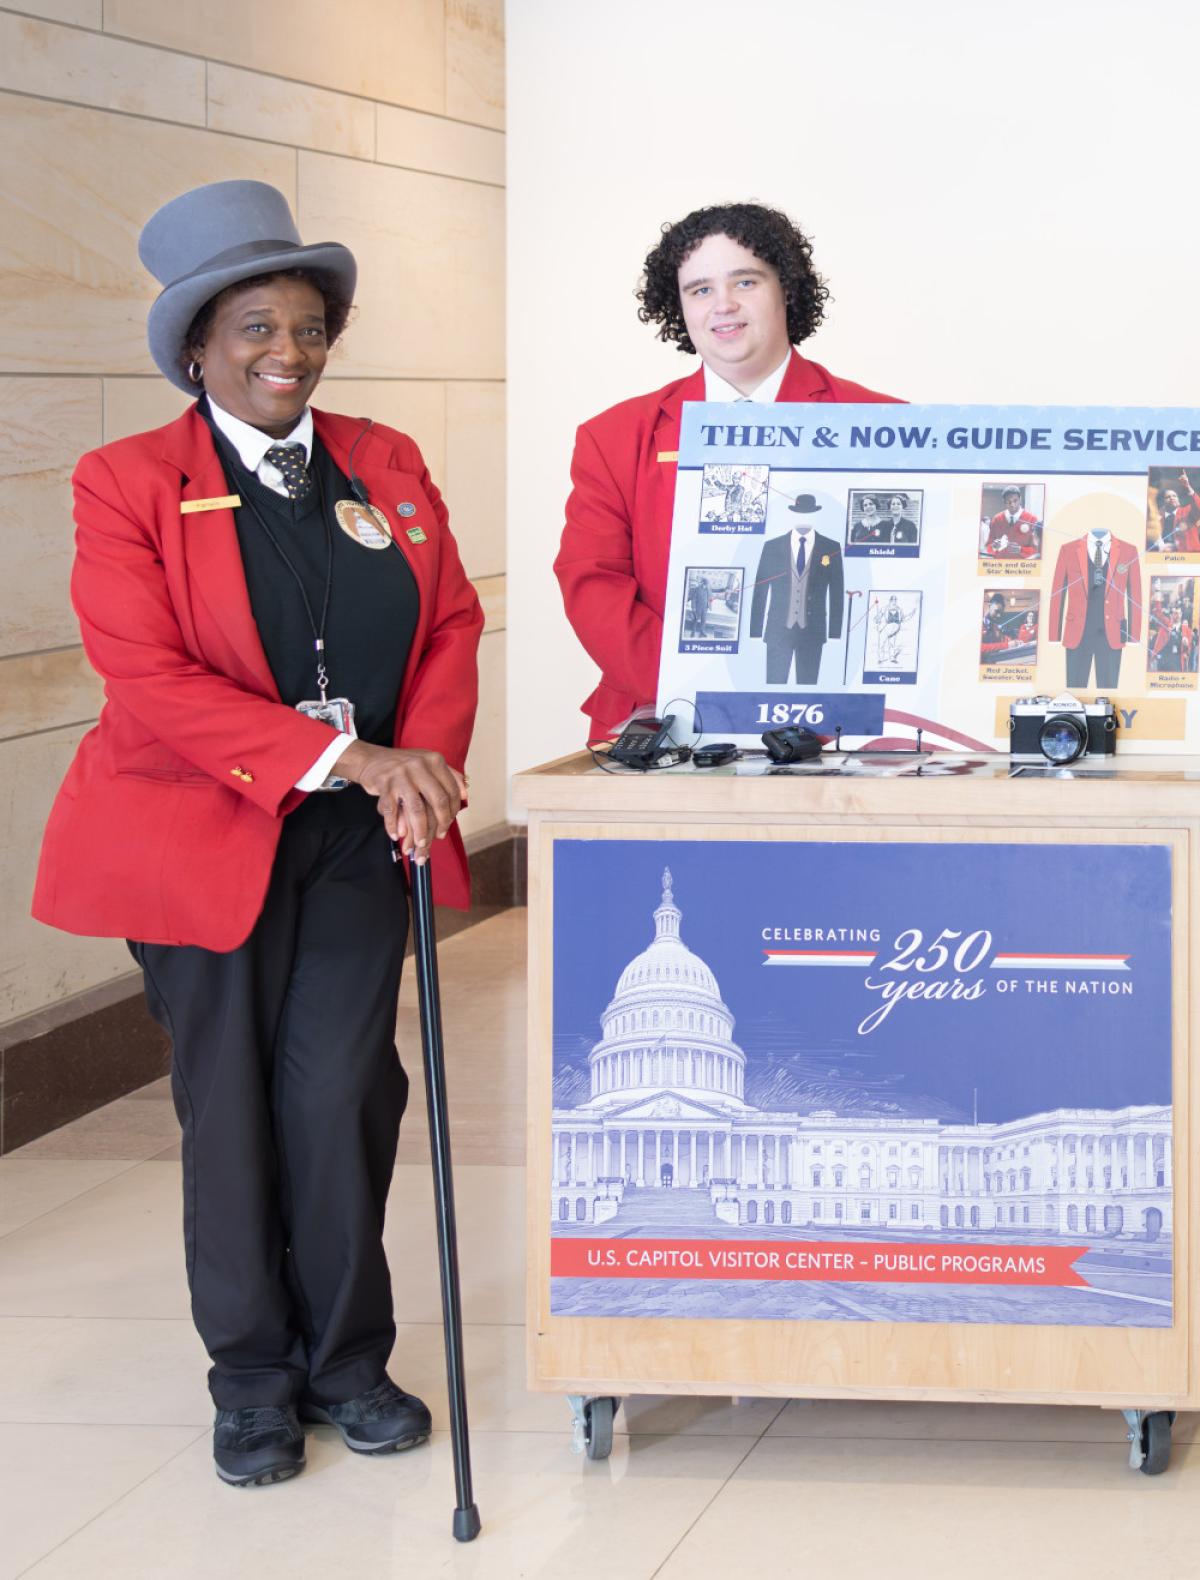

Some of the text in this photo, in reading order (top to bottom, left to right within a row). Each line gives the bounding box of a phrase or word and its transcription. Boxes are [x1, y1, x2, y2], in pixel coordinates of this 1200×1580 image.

[700, 425, 804, 447] THEN
[812, 426, 839, 448] &
[850, 426, 937, 448] NOW:
[946, 428, 1052, 450] GUIDE
[711, 524, 736, 533] Derby
[756, 703, 824, 724] 1876
[762, 927, 880, 942] CELEBRATING
[880, 928, 992, 974] 250
[996, 980, 1134, 995] OF THE NATION
[858, 976, 987, 1035] years
[587, 1250, 620, 1267] U.S.
[626, 1249, 704, 1268] CAPITOL
[708, 1250, 780, 1270] VISITOR
[784, 1251, 854, 1271] CENTER
[874, 1254, 936, 1272] PUBLIC
[941, 1254, 1046, 1274] PROGRAMS
